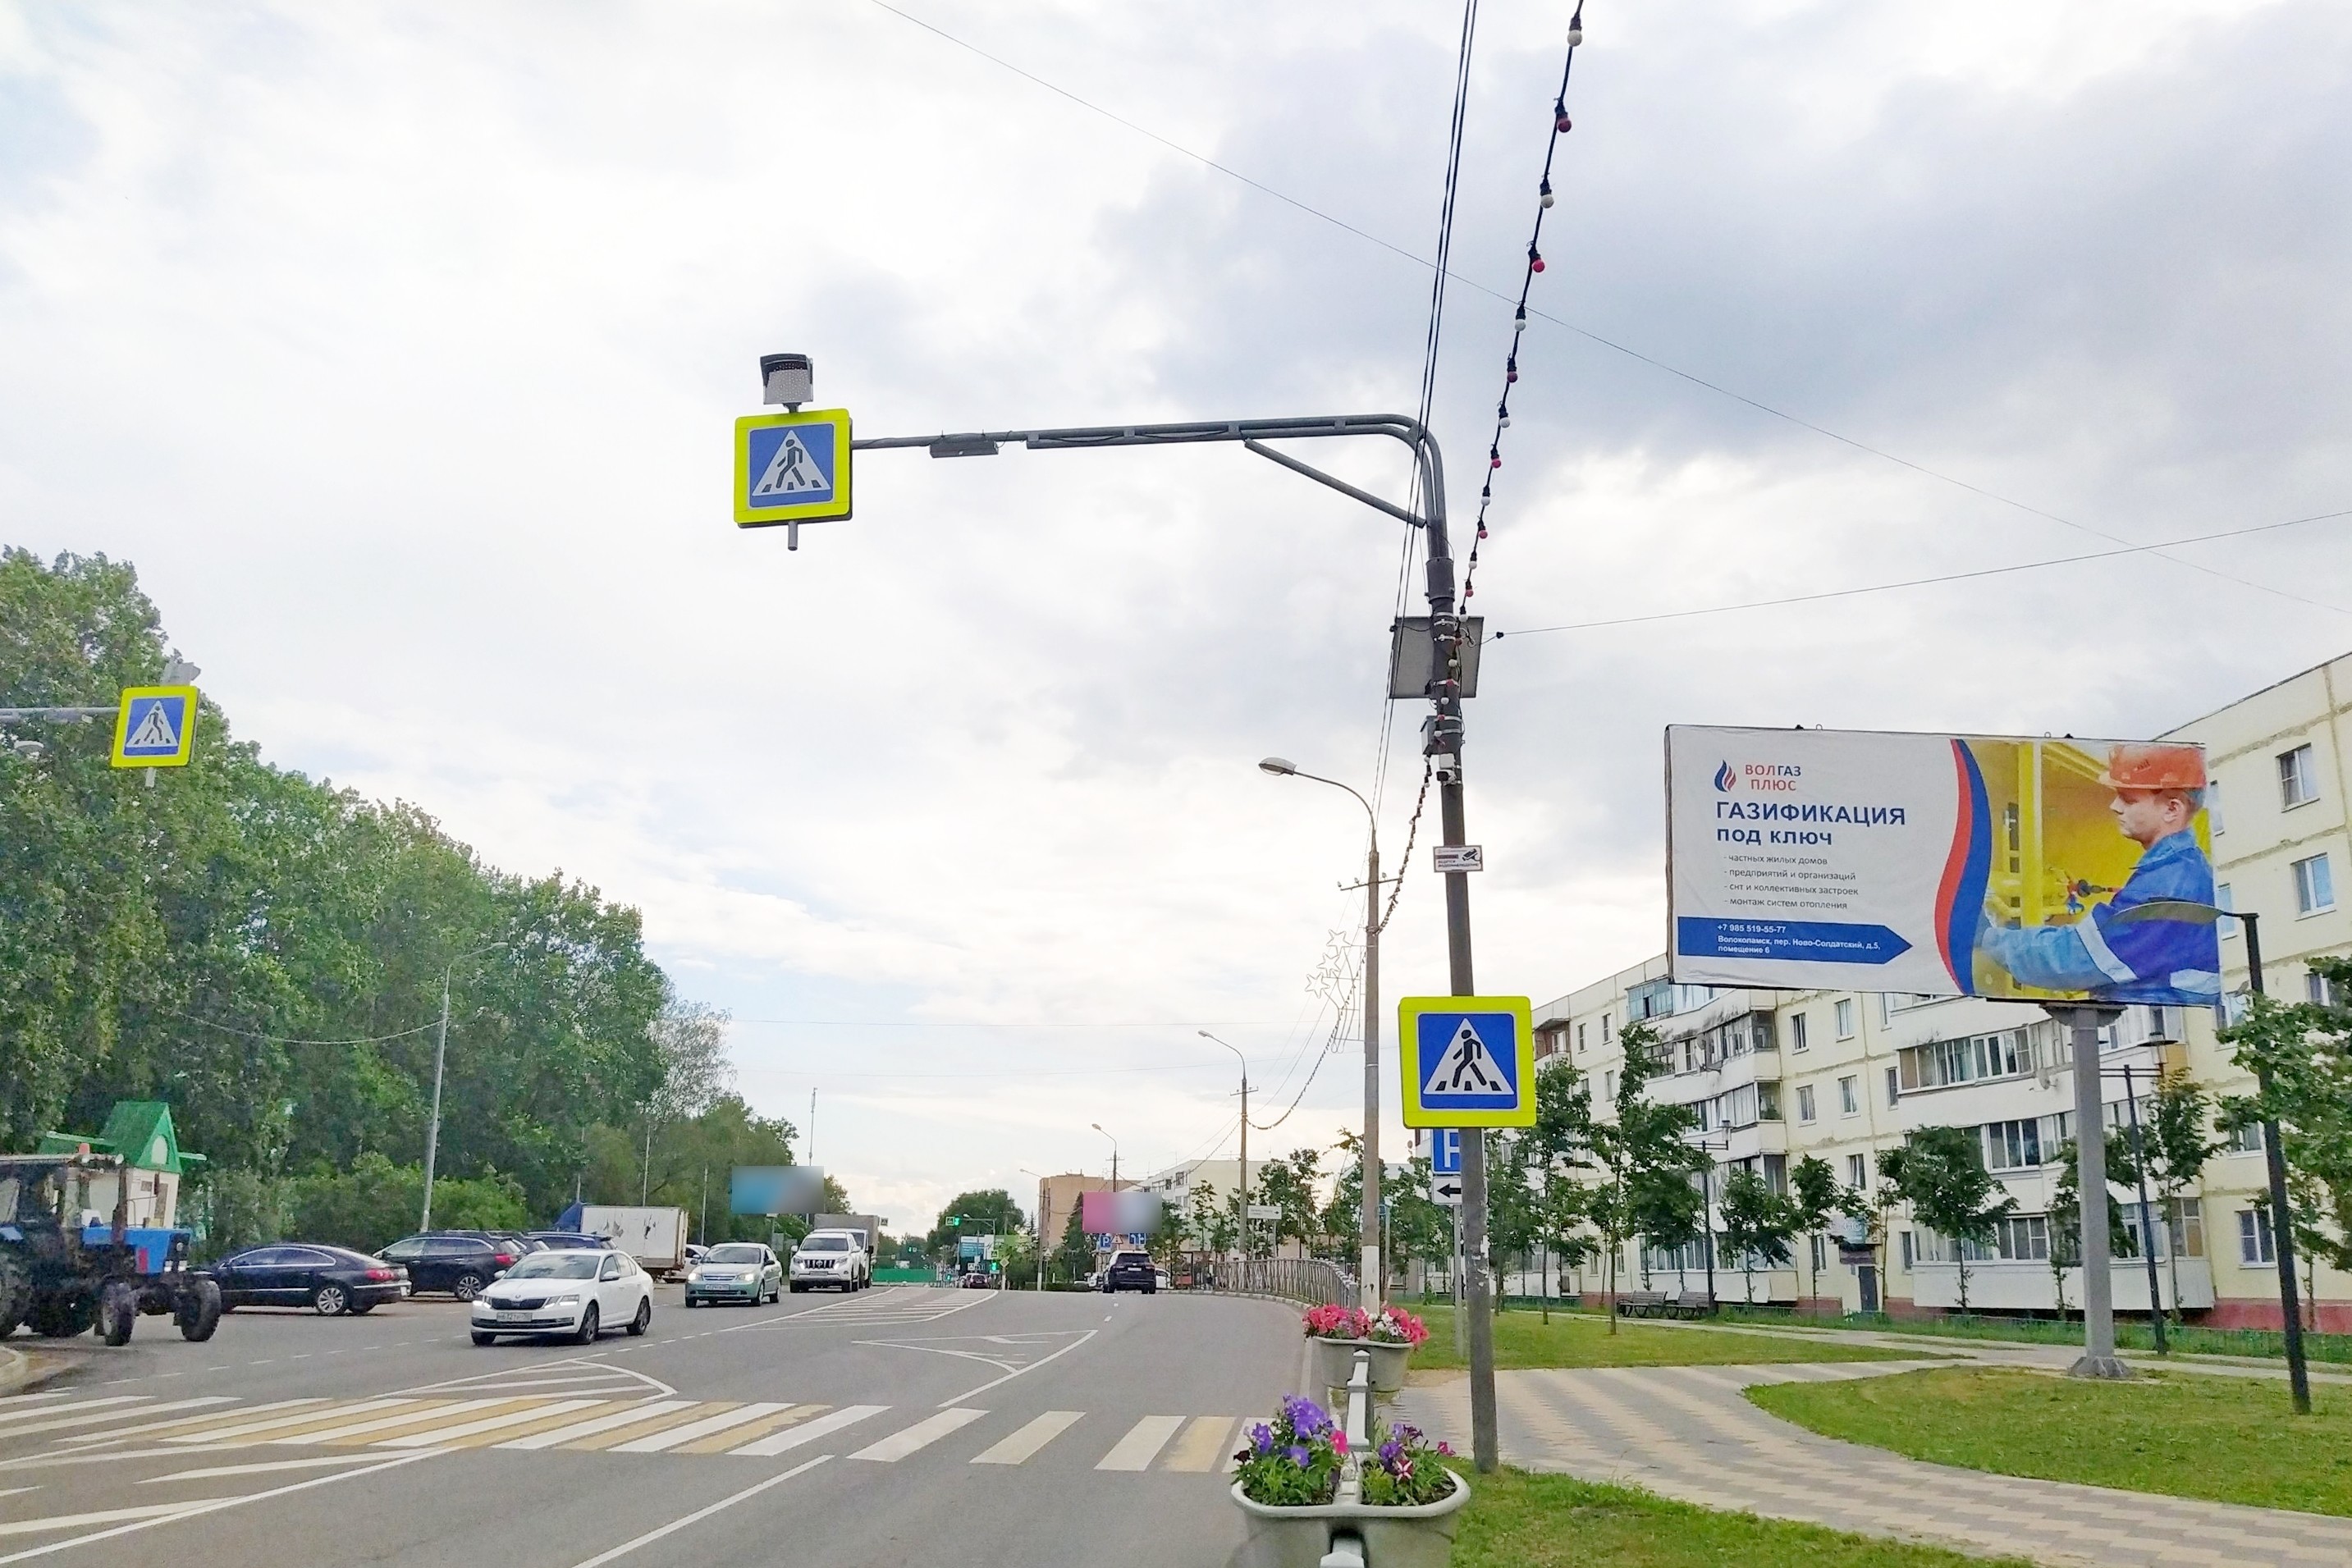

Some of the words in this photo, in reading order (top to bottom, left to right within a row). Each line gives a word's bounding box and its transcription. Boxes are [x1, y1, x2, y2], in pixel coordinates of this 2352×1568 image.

[1745, 764, 1802, 777] ВОЛГАЗ
[1750, 779, 1797, 792] ПЛЮС
[1716, 801, 1906, 828] ГАЗИФИКАЦИЯ
[1728, 855, 1765, 863] частных
[1766, 856, 1796, 864] жилых
[1798, 857, 1828, 866] домов
[1729, 869, 1788, 878] предприятий
[1798, 871, 1856, 881] организаций
[1754, 885, 1817, 894] коллективных
[1819, 887, 1859, 895] застроек
[1766, 899, 1798, 907] систем
[1800, 901, 1848, 909] отопления
[1717, 923, 1727, 931] +7
